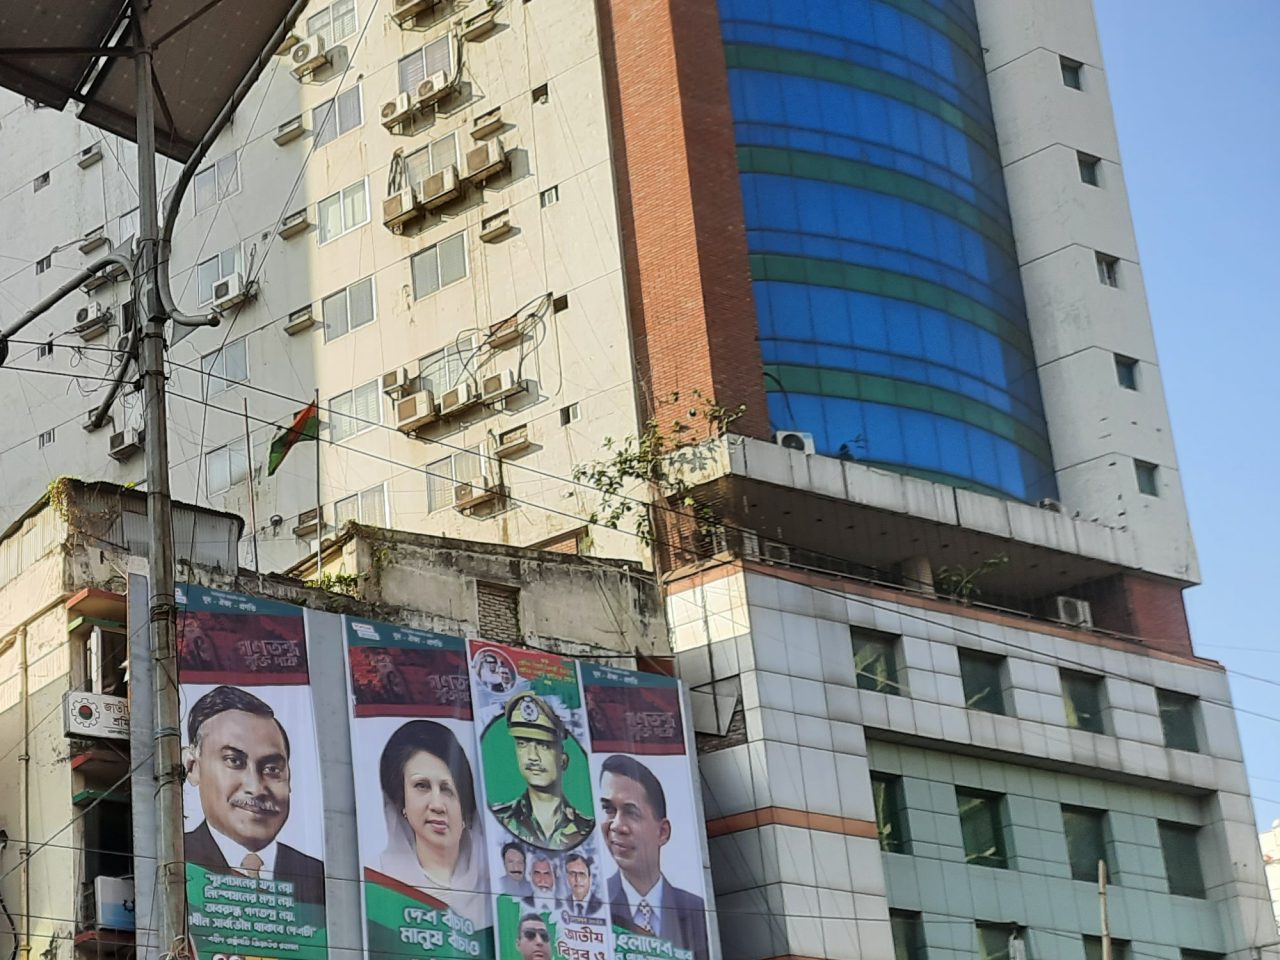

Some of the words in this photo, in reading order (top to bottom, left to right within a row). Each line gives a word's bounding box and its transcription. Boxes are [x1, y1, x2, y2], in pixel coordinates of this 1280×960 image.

[404, 907, 437, 925] দেশ
[400, 927, 443, 950] মানুষ
[564, 926, 604, 944] জাতীয়
[617, 934, 673, 957] ংলাদেশ
